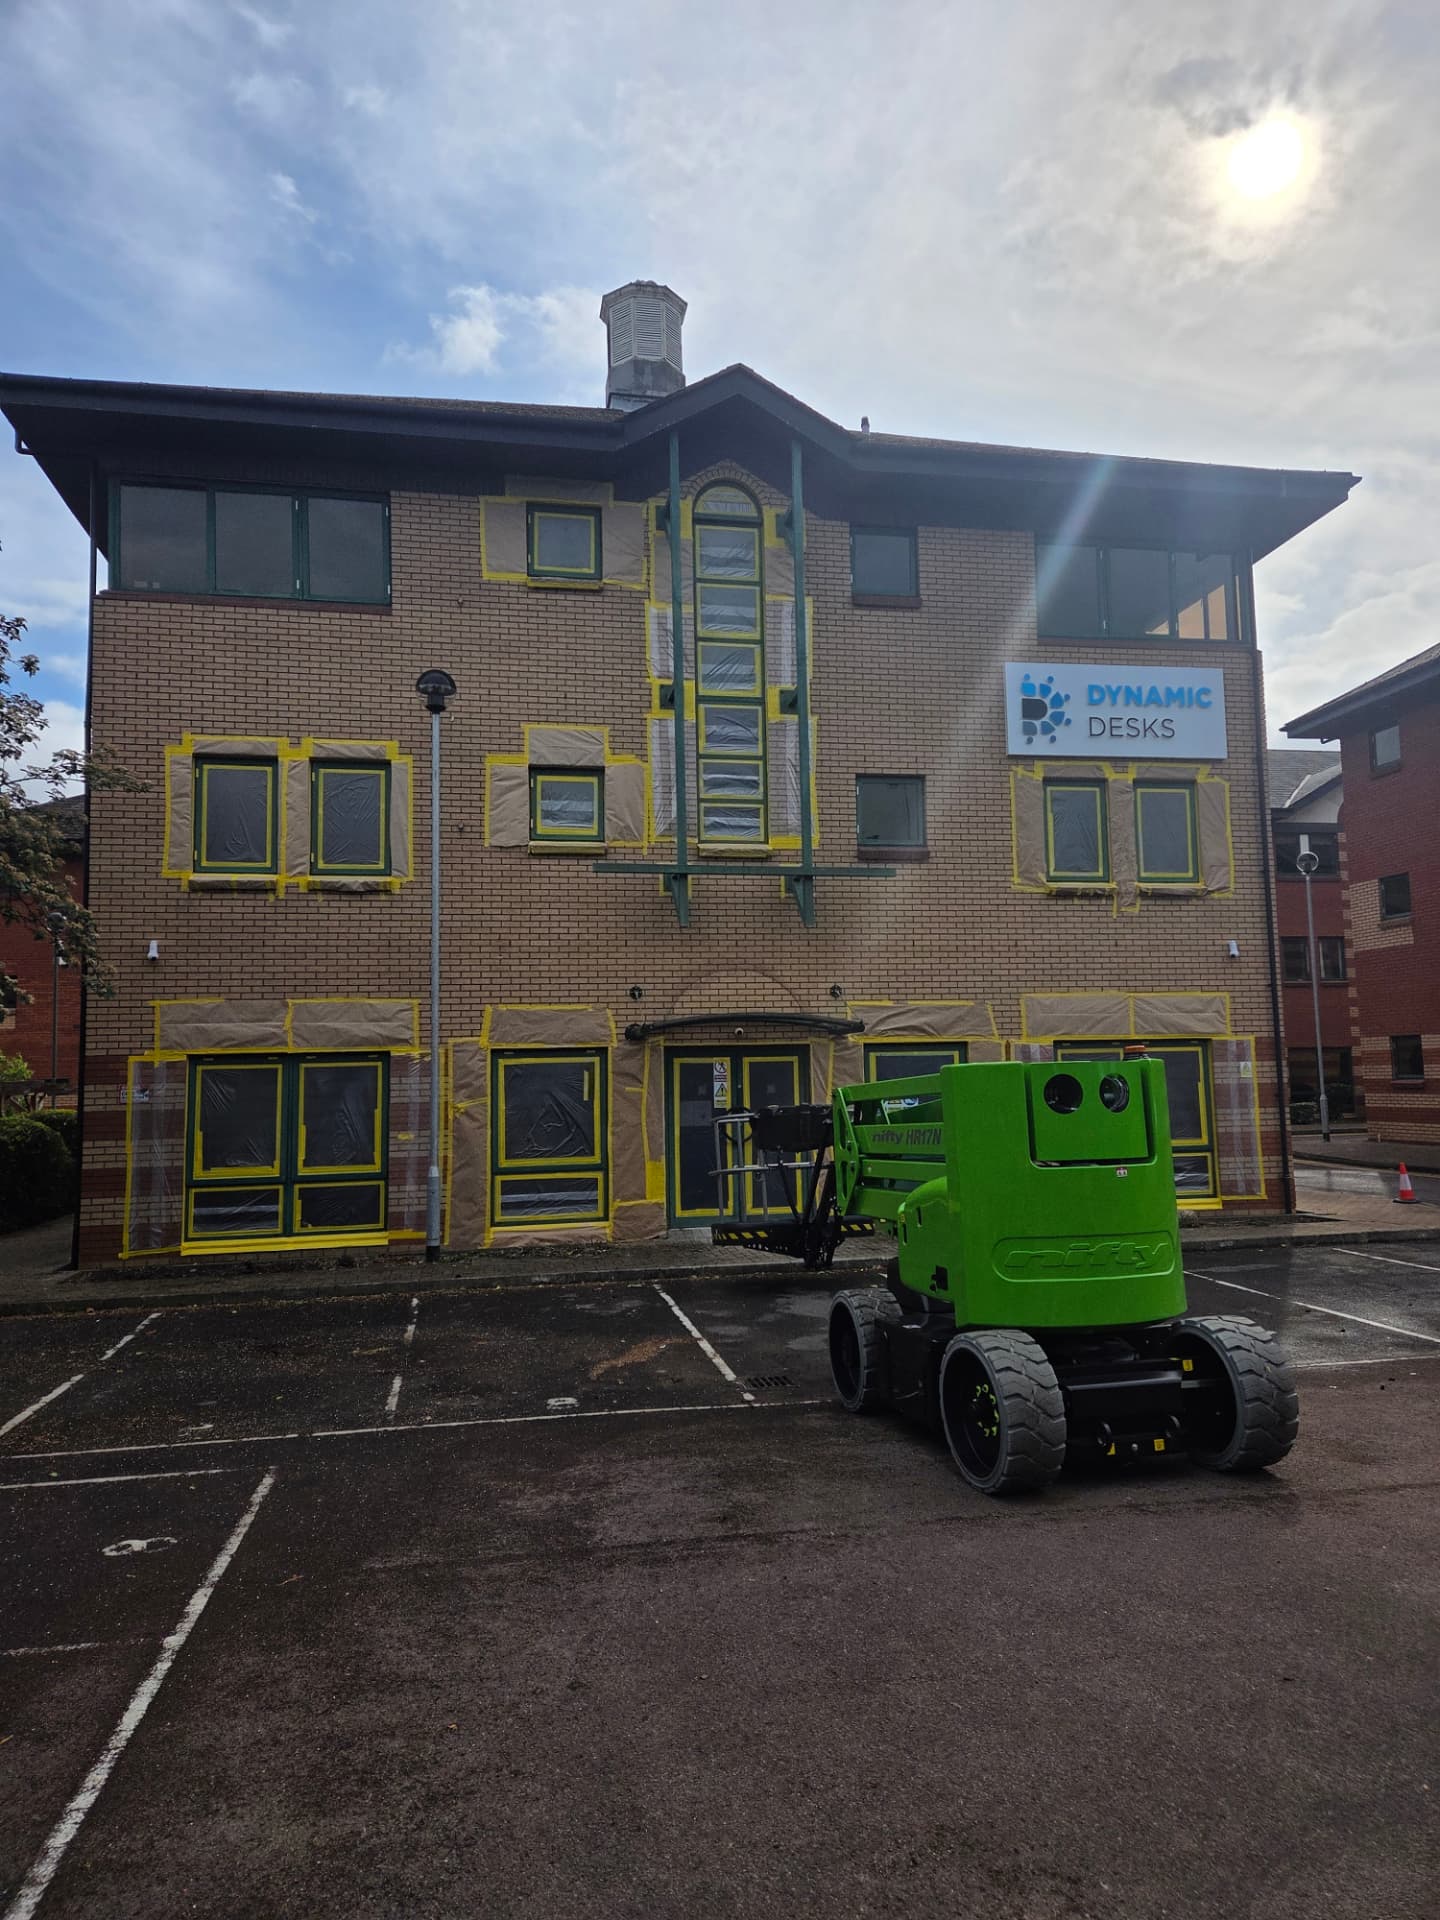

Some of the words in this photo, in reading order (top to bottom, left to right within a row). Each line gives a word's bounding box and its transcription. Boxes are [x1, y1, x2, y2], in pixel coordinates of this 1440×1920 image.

[1087, 684, 1213, 708] DYNAMIC
[1088, 716, 1176, 738] DESKS
[872, 1130, 902, 1144] nifty
[1004, 1241, 1169, 1269] nifty
